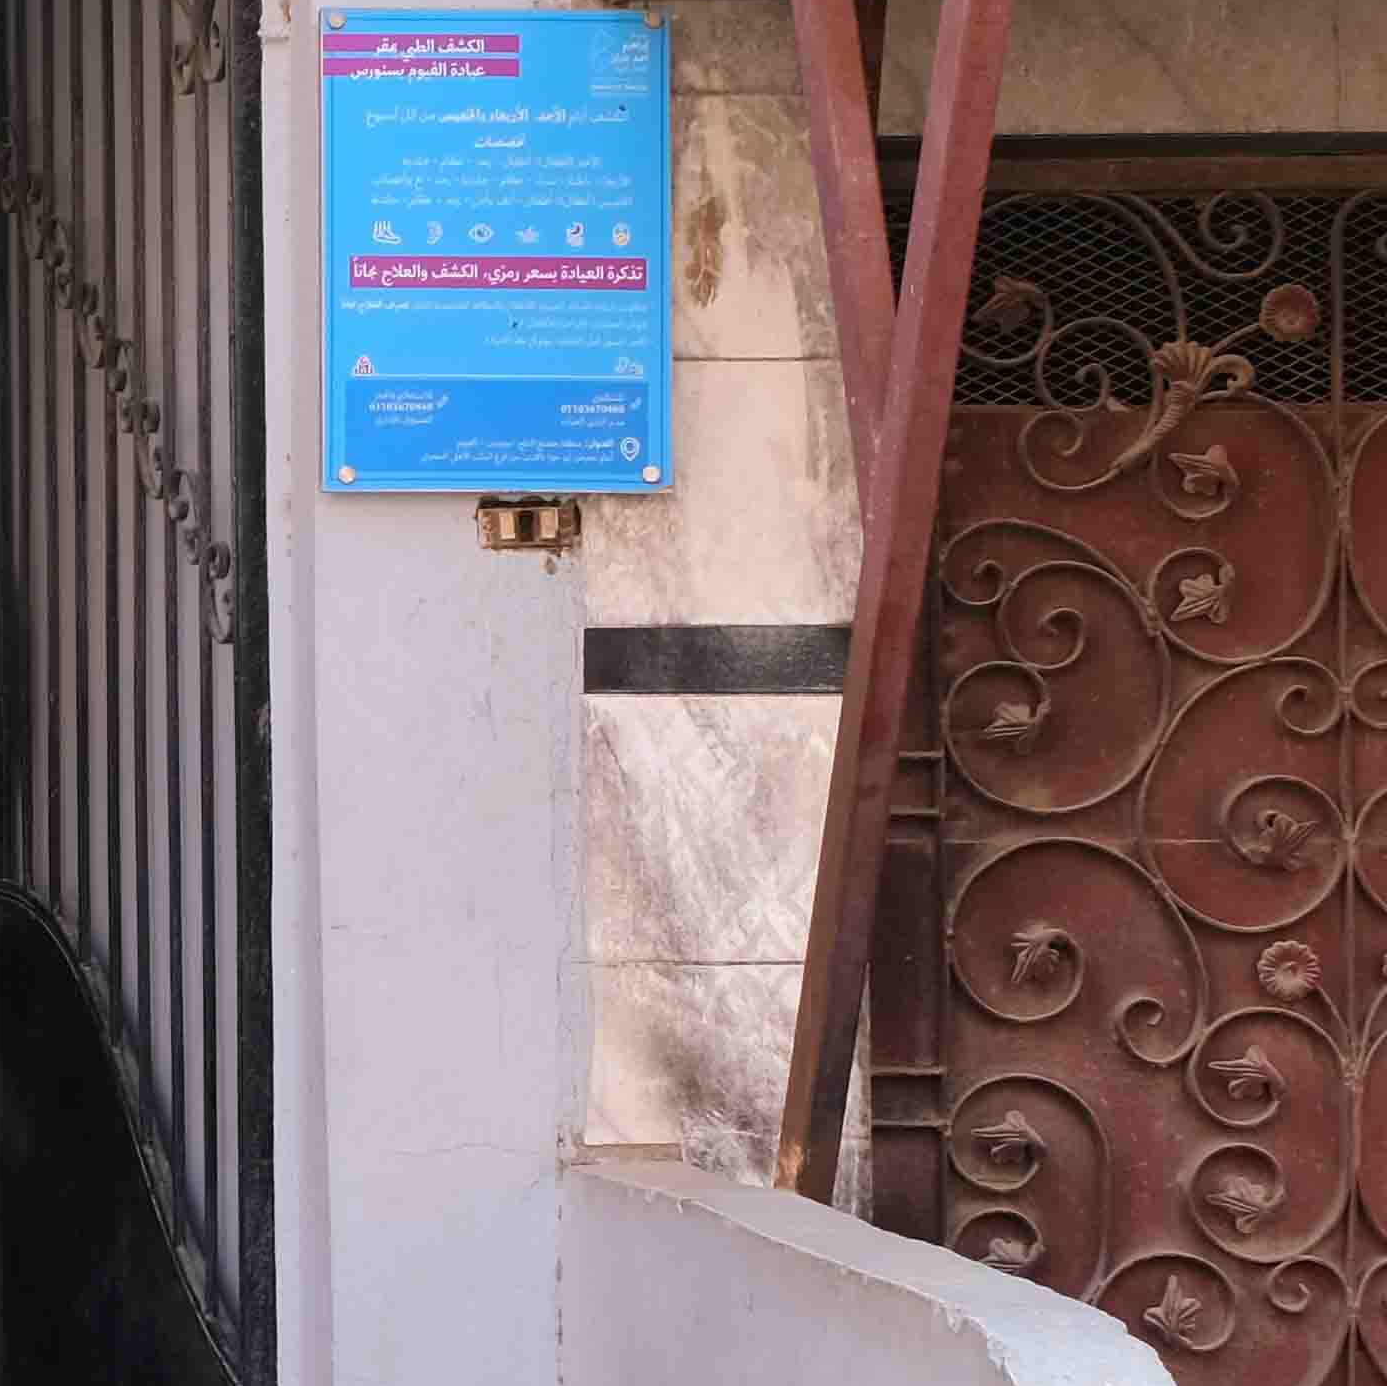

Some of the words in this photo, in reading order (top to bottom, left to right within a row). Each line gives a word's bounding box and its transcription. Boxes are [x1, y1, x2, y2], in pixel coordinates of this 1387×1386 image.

[449, 61, 487, 79] عيادة
[380, 262, 428, 286] والعلاج
[431, 262, 479, 280] الكشف
[522, 268, 558, 284] بسعر
[560, 263, 604, 285] العيادة
[607, 263, 644, 282] تذكرة
